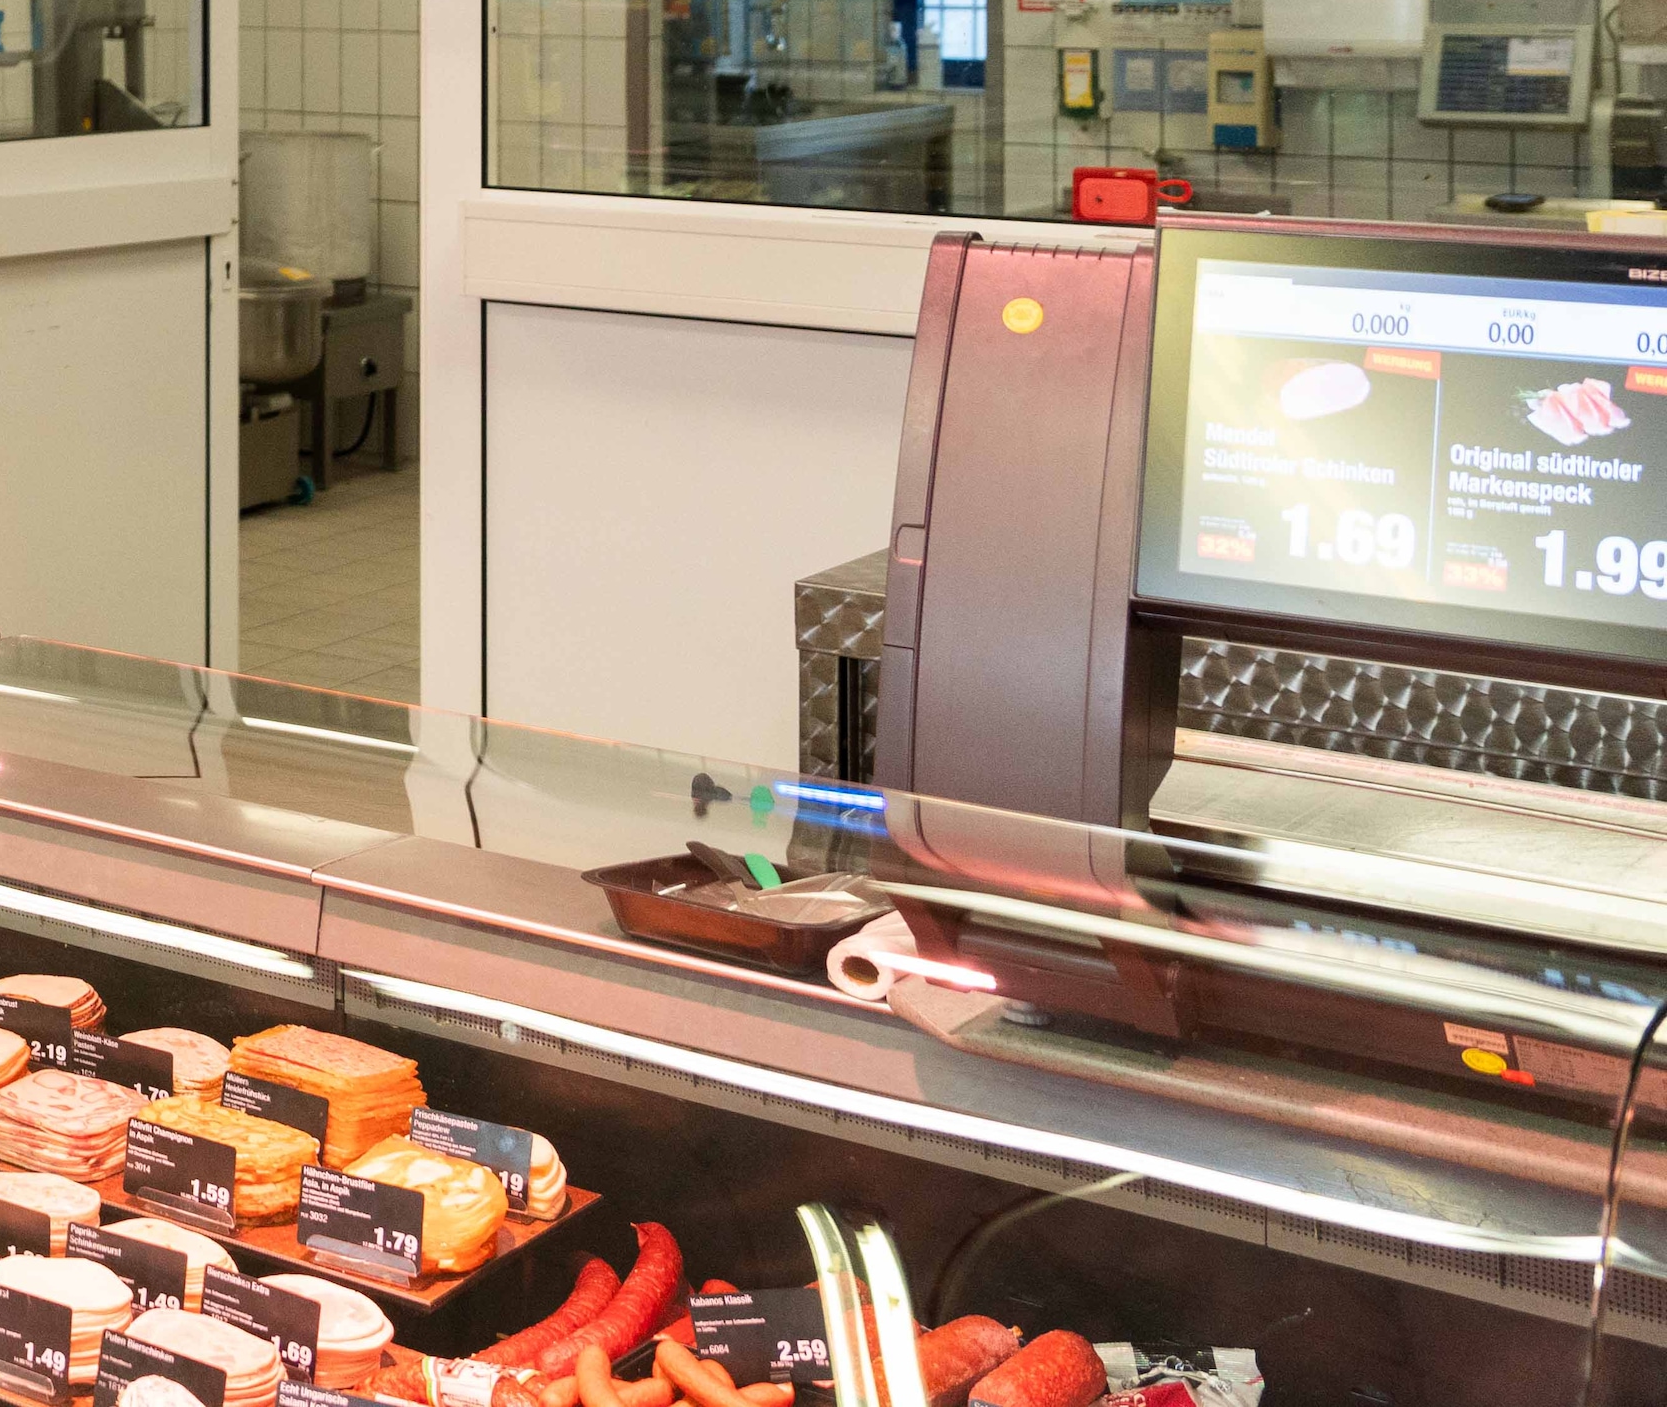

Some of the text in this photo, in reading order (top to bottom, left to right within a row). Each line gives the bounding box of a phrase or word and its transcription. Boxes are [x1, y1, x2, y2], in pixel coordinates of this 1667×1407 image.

[1352, 313, 1409, 336] 0,000
[1488, 322, 1535, 345] 0,00
[1372, 352, 1433, 373] WERBUNG
[1203, 448, 1395, 486] Südtiroler Schinken
[1450, 444, 1643, 482] Original südtiroler
[1449, 471, 1593, 505] Markenspeck
[1281, 502, 1415, 568] 1.69
[1535, 530, 1667, 600] 1.99
[31, 1040, 67, 1062] 2.19
[73, 1030, 119, 1049] Weinblatt-Käse
[225, 1081, 271, 1103] Heidefrühstück
[413, 1119, 451, 1136] Peppadew
[414, 1109, 479, 1132] Frischkäsepastete
[129, 1130, 154, 1144] in Aspik
[153, 1124, 194, 1145] Champignon
[134, 1162, 151, 1174] 3014
[303, 1166, 375, 1192] Hähnchen-Brustfilet
[191, 1178, 230, 1205] 1.59
[322, 1181, 329, 1192] in
[330, 1184, 351, 1197] Aspik
[309, 1210, 328, 1223] 3032
[70, 1224, 100, 1239] Paprika-
[374, 1226, 418, 1254] 1.79
[69, 1235, 122, 1257] Schinkenwurst
[206, 1265, 270, 1296] Bierschinken Extra
[138, 1287, 180, 1310] 1.49
[690, 1294, 753, 1307] Kabanos Klassik
[25, 1341, 66, 1371] 1.49
[105, 1332, 175, 1363] Puten Bierschinken
[270, 1334, 313, 1366] 1.69
[709, 1344, 729, 1355] 6084
[777, 1339, 827, 1361] 2.59
[280, 1382, 299, 1396] Echt
[299, 1387, 349, 1406] Ungarische
